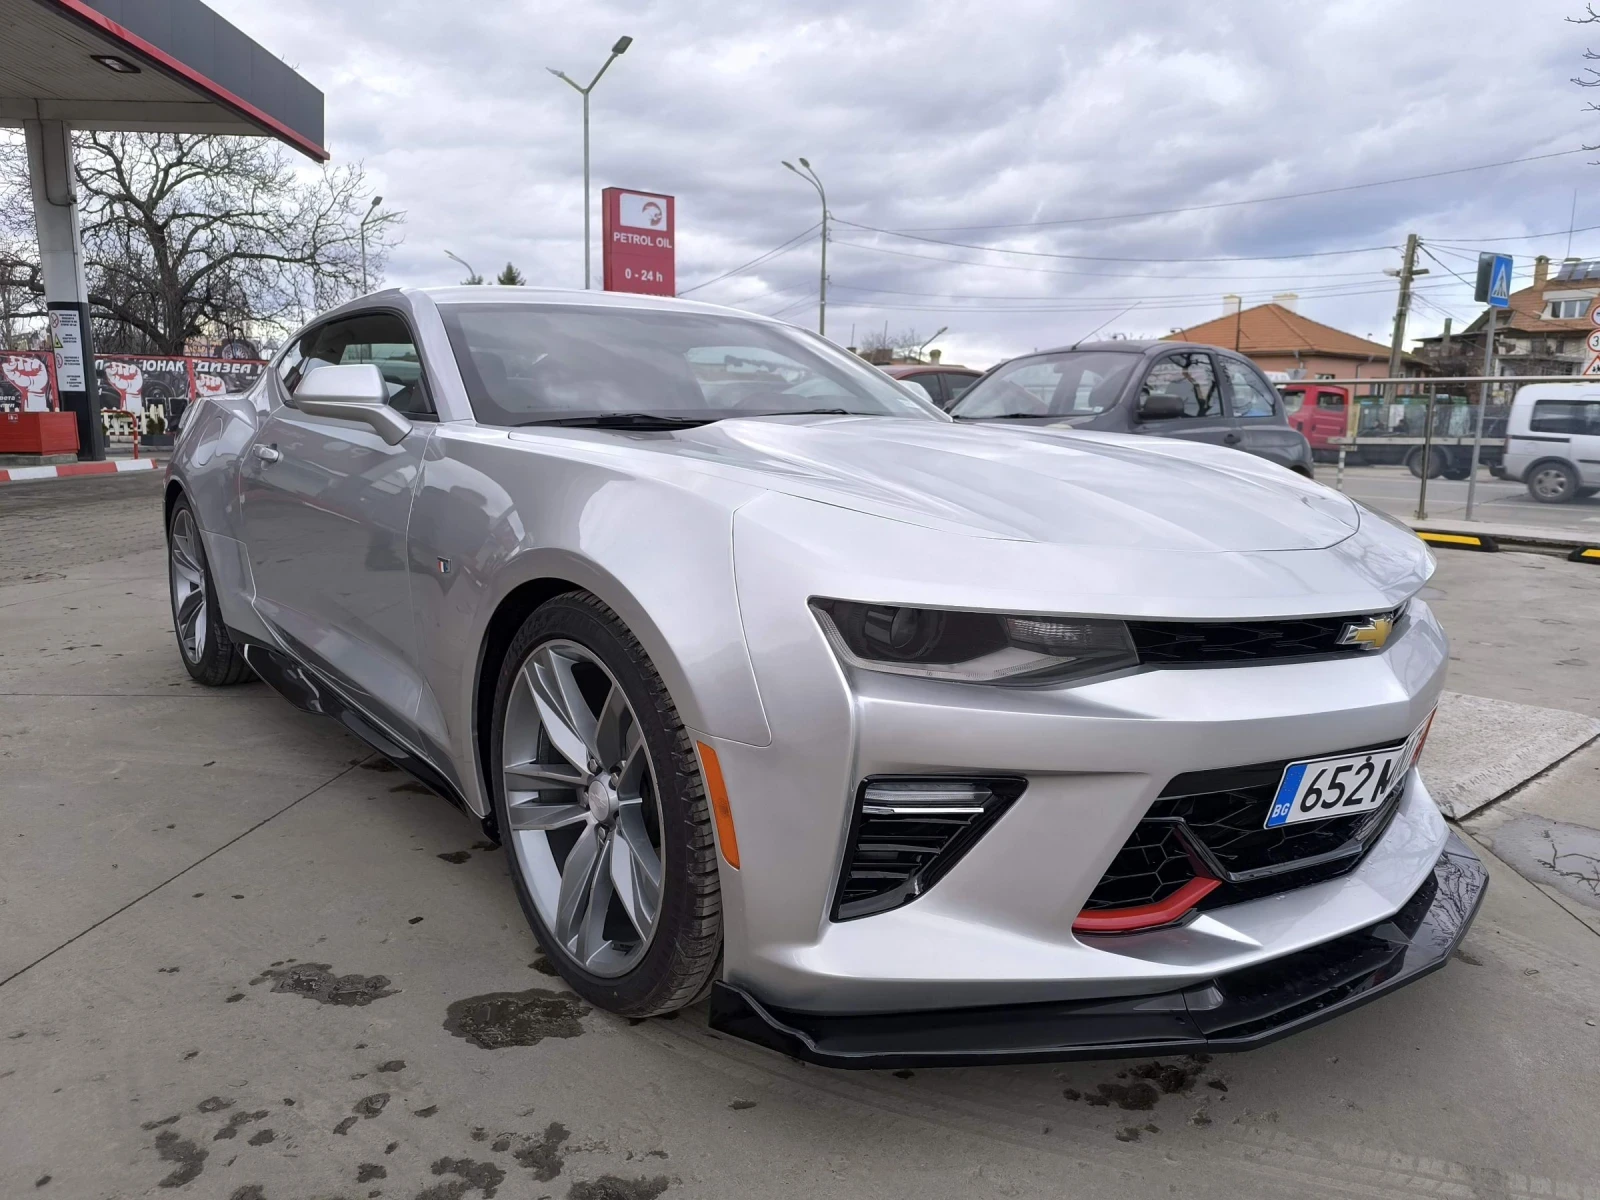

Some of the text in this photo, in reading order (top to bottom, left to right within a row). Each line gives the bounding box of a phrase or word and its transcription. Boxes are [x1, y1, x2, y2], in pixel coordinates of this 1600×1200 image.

[613, 232, 672, 248] PETROL OIL
[625, 268, 632, 279] 0
[641, 270, 653, 281] 24
[656, 272, 663, 282] h
[1300, 762, 1376, 813] 652
[1271, 802, 1291, 818] BG
